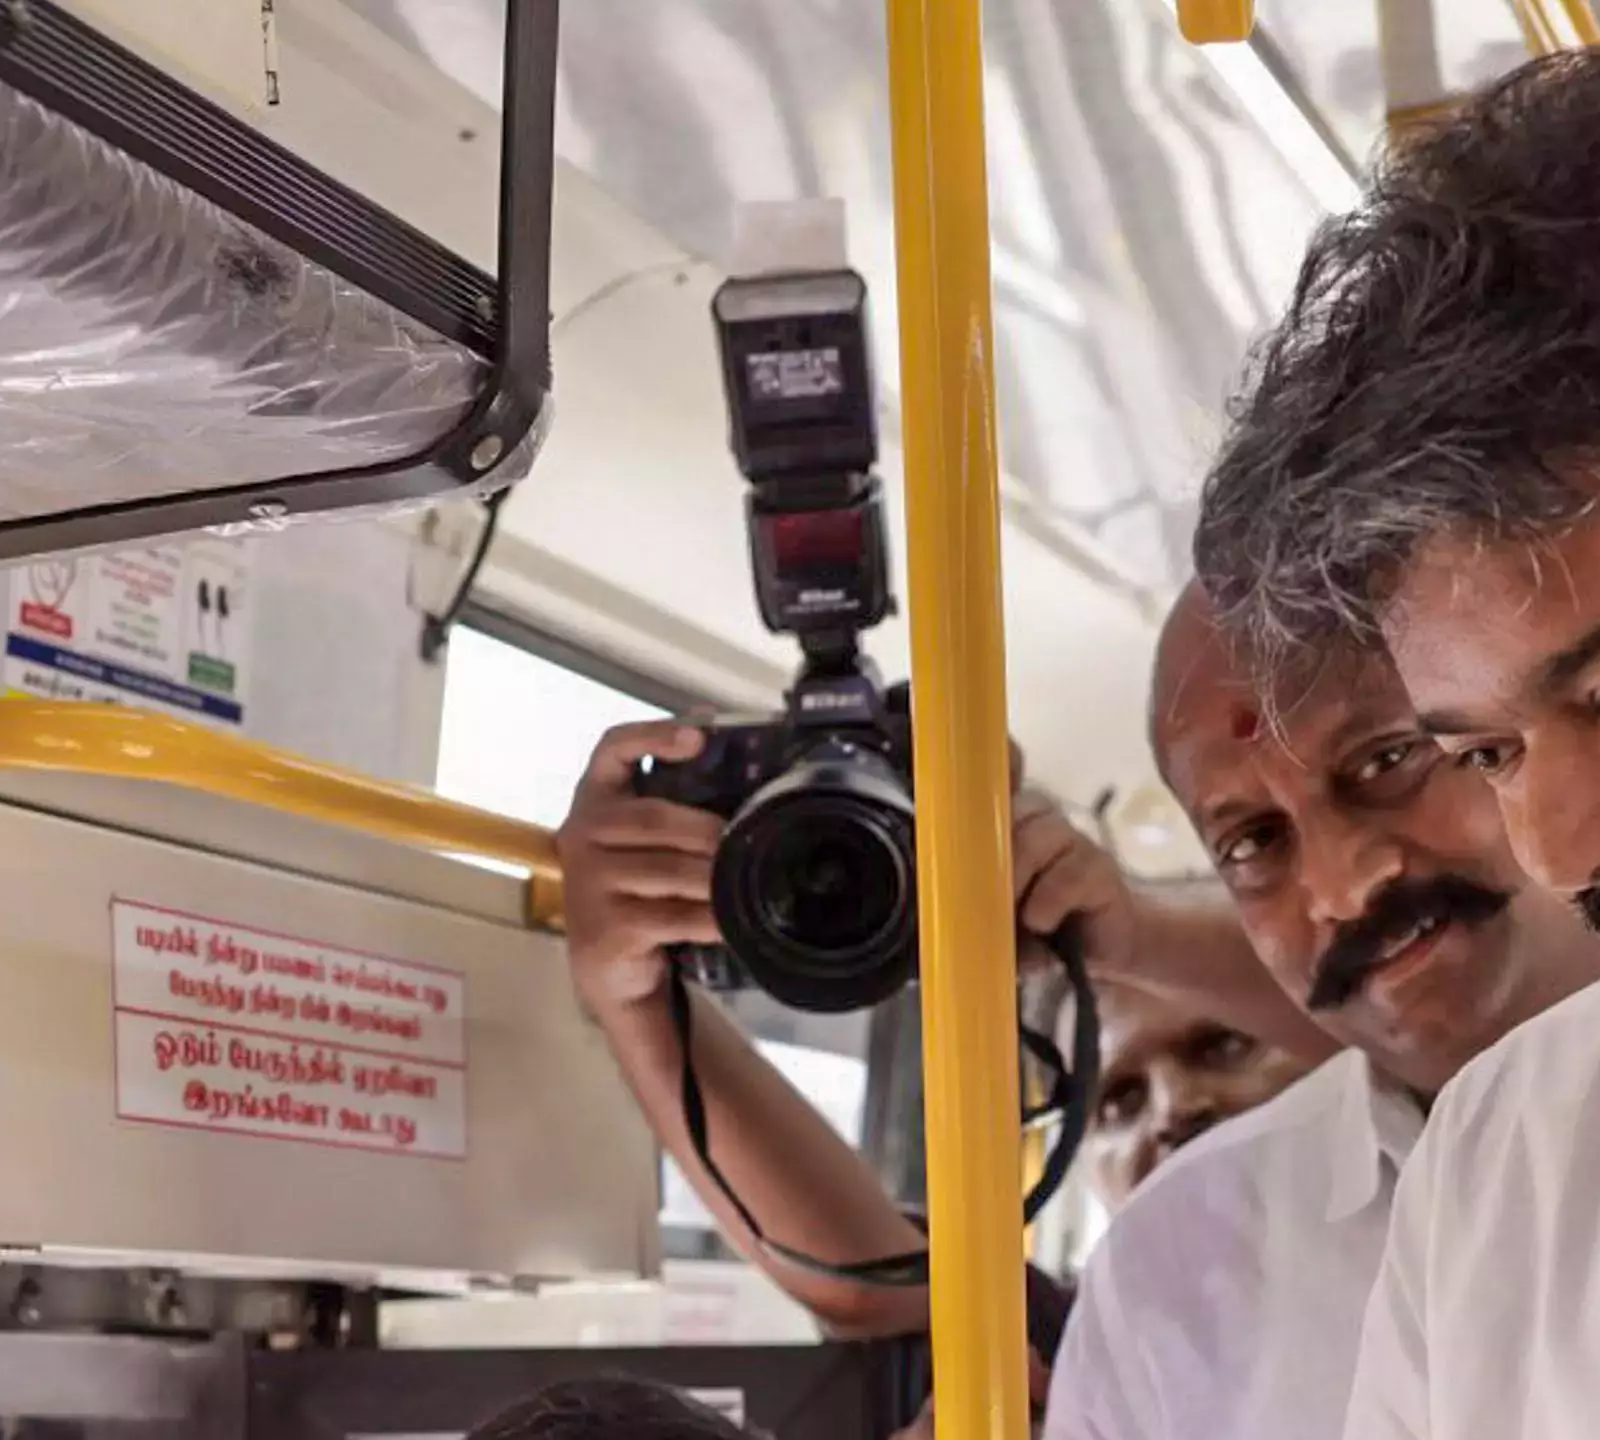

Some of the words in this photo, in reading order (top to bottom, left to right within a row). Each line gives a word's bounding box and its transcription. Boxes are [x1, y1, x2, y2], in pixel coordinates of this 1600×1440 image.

[154, 1031, 221, 1071] ஓடும்
[227, 1037, 344, 1086] பேருந்தில்
[352, 1064, 438, 1100] ஏறவோ
[183, 1080, 330, 1129] இறங்கவோ
